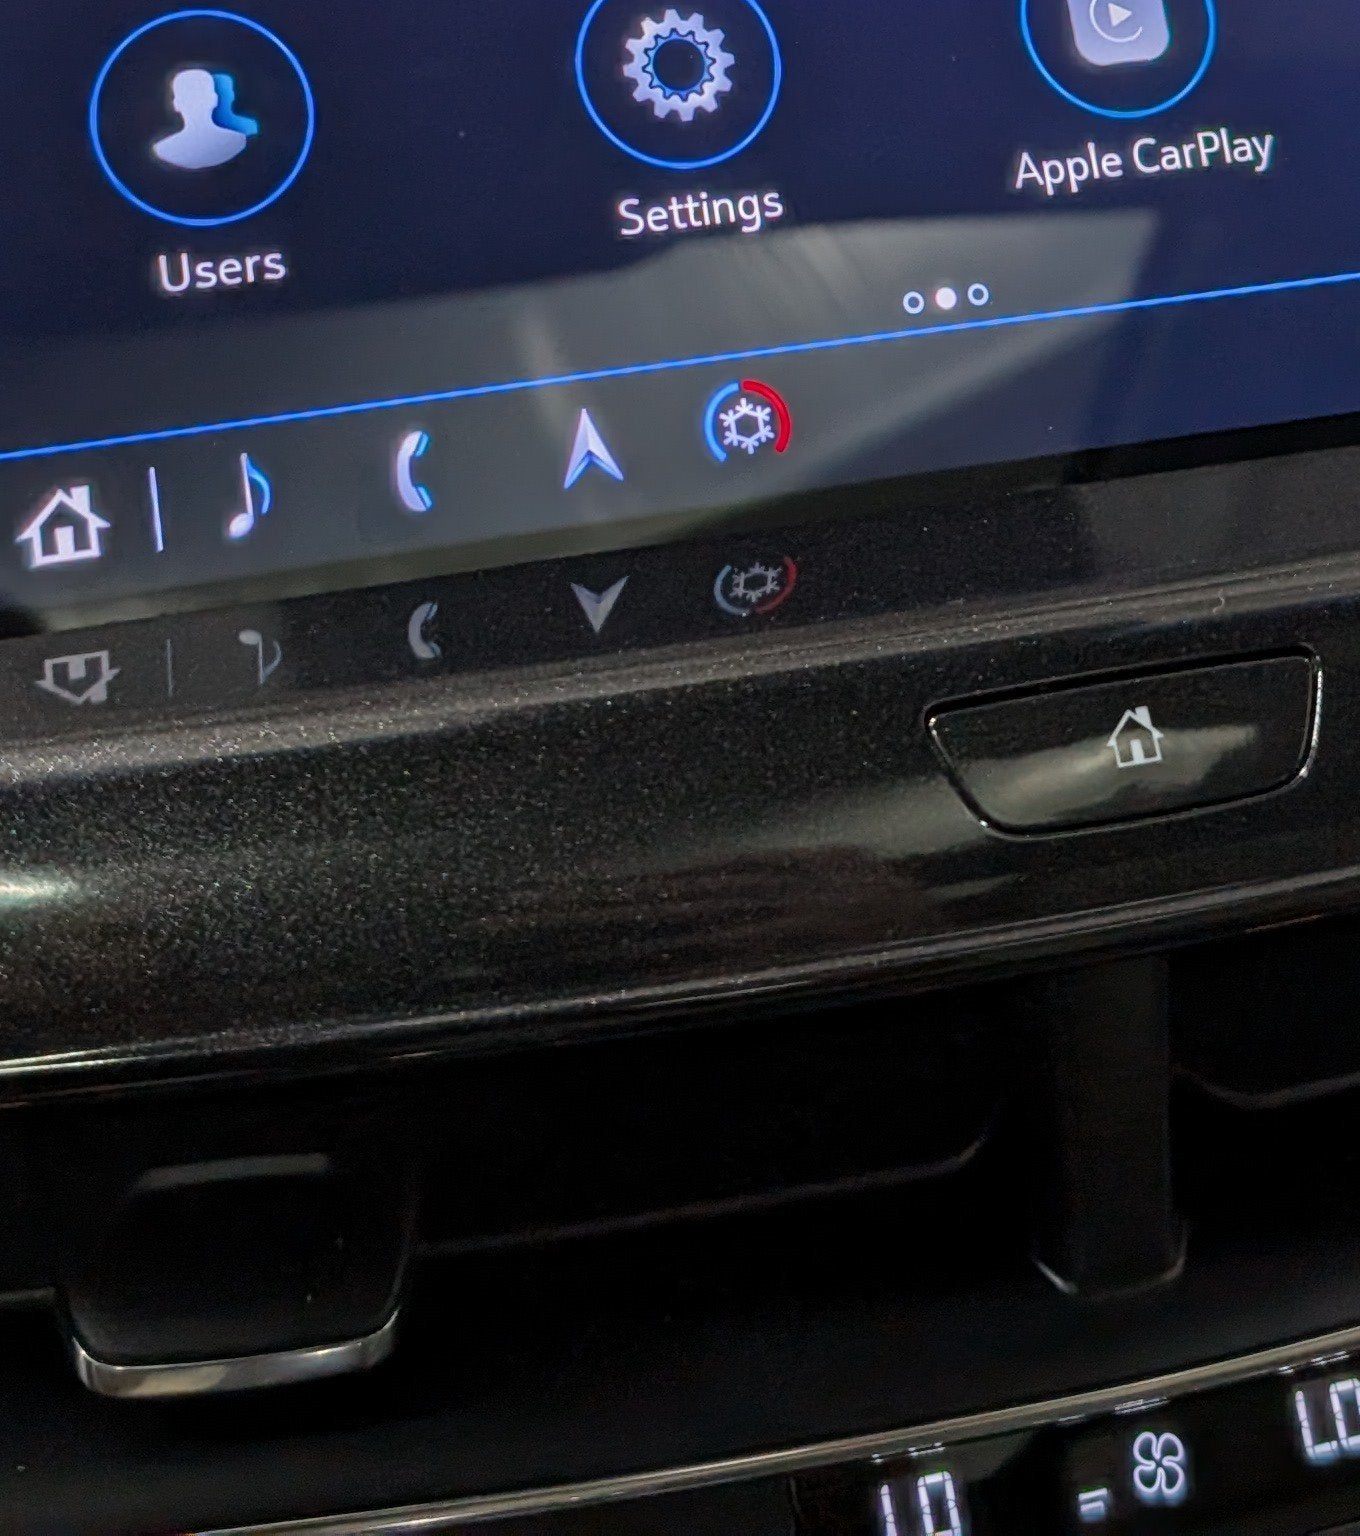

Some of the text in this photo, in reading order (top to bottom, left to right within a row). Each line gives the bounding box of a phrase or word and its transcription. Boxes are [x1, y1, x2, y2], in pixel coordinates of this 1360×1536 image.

[1014, 128, 1274, 196] Apple CarPlay
[618, 189, 784, 237] Settings
[157, 250, 288, 293] Users
